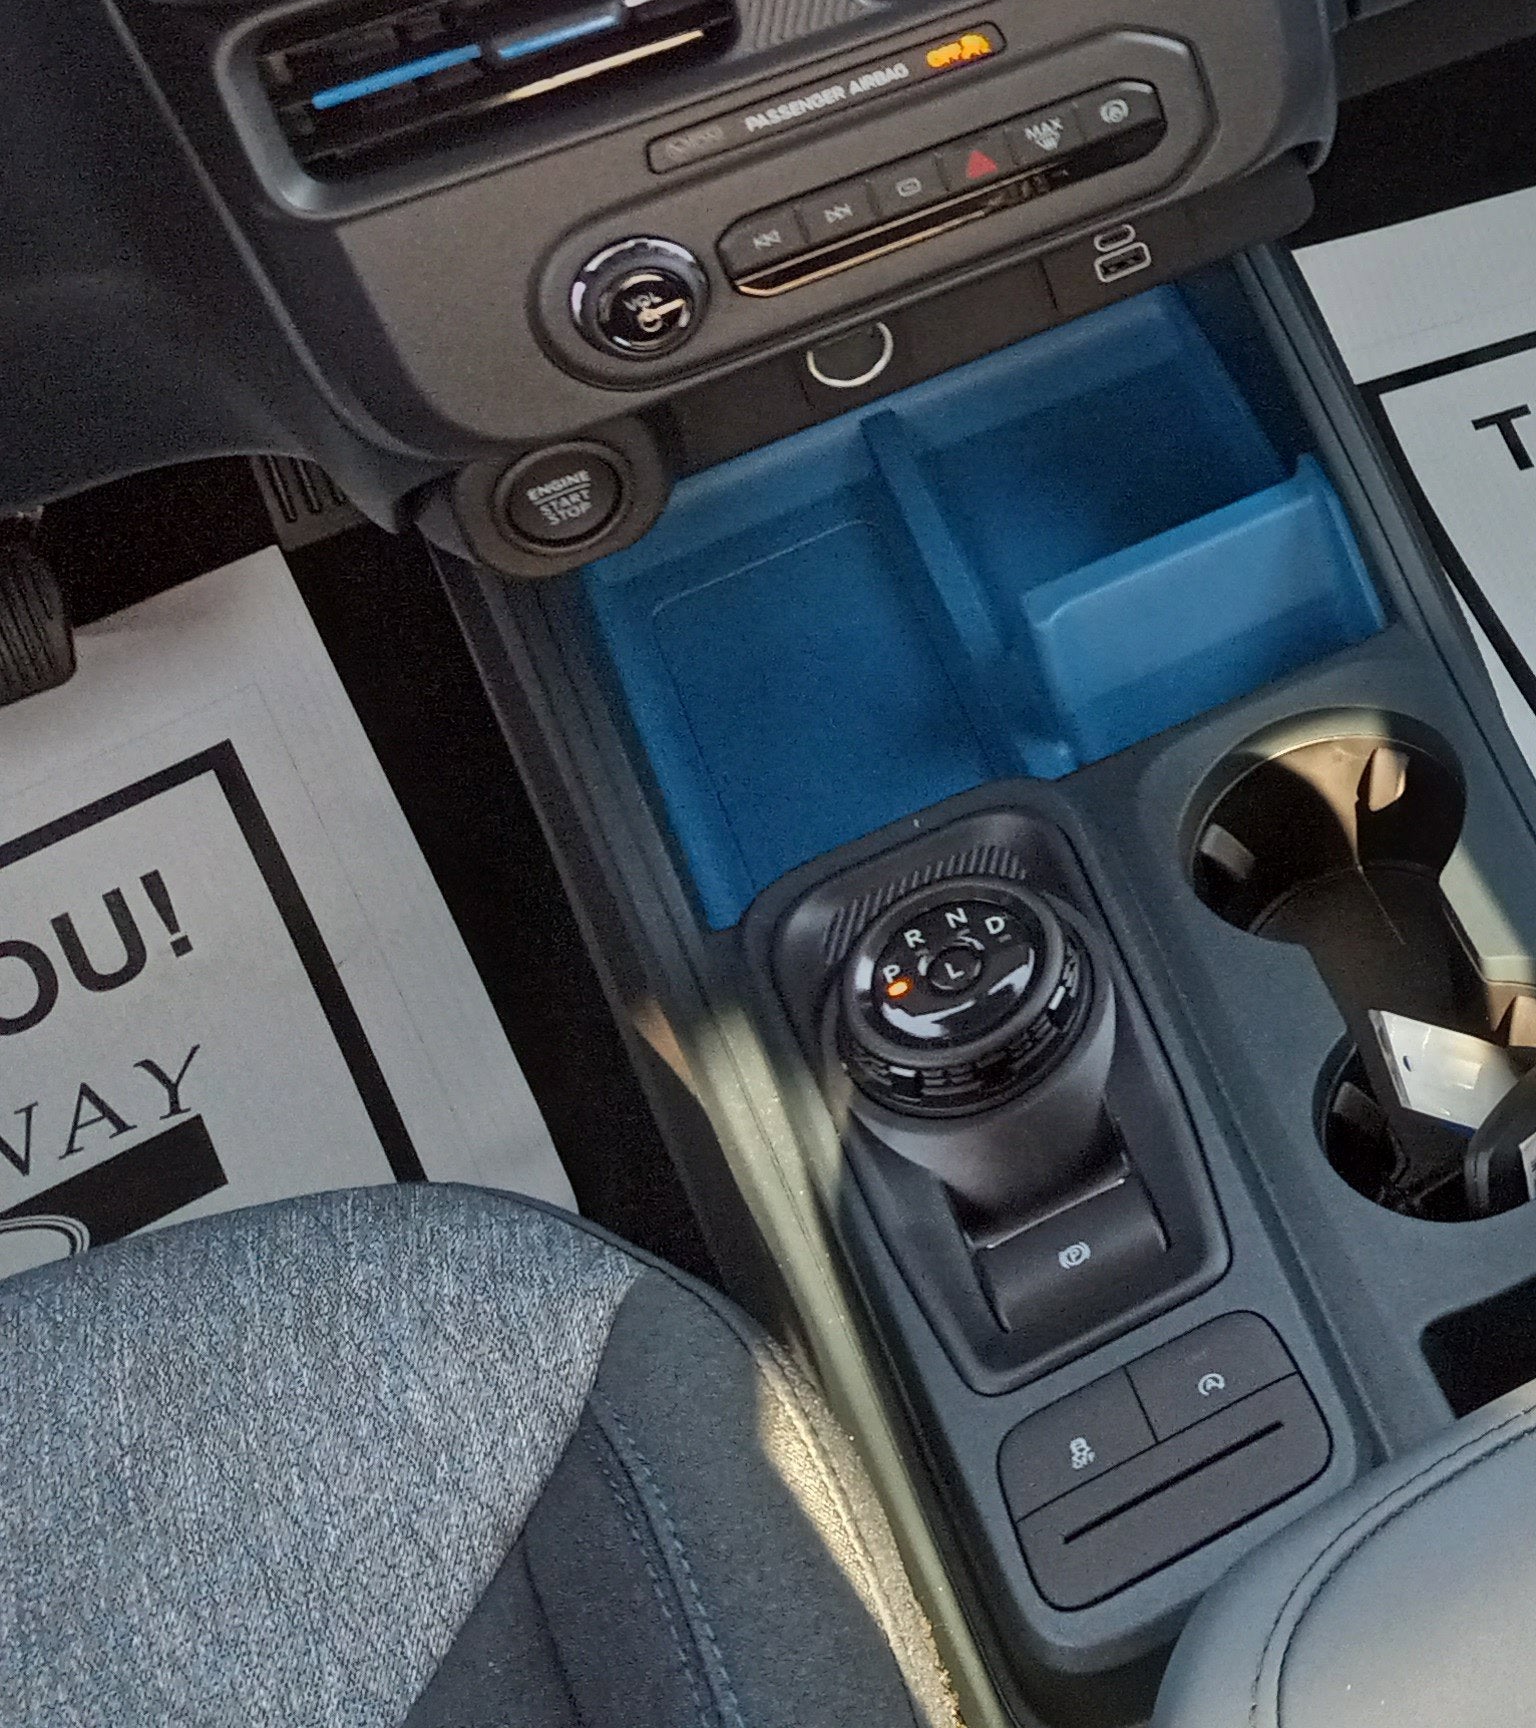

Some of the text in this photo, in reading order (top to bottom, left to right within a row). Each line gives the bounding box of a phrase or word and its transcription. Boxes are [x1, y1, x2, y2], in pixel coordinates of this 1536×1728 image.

[744, 62, 910, 133] PASSENGER AIRBAG
[526, 469, 592, 501] ENGINE
[540, 489, 591, 515] START
[548, 501, 592, 526] STOP
[945, 907, 968, 928] N
[985, 916, 1005, 934] D
[903, 929, 926, 948] R
[882, 964, 901, 983] P
[945, 962, 965, 979] L
